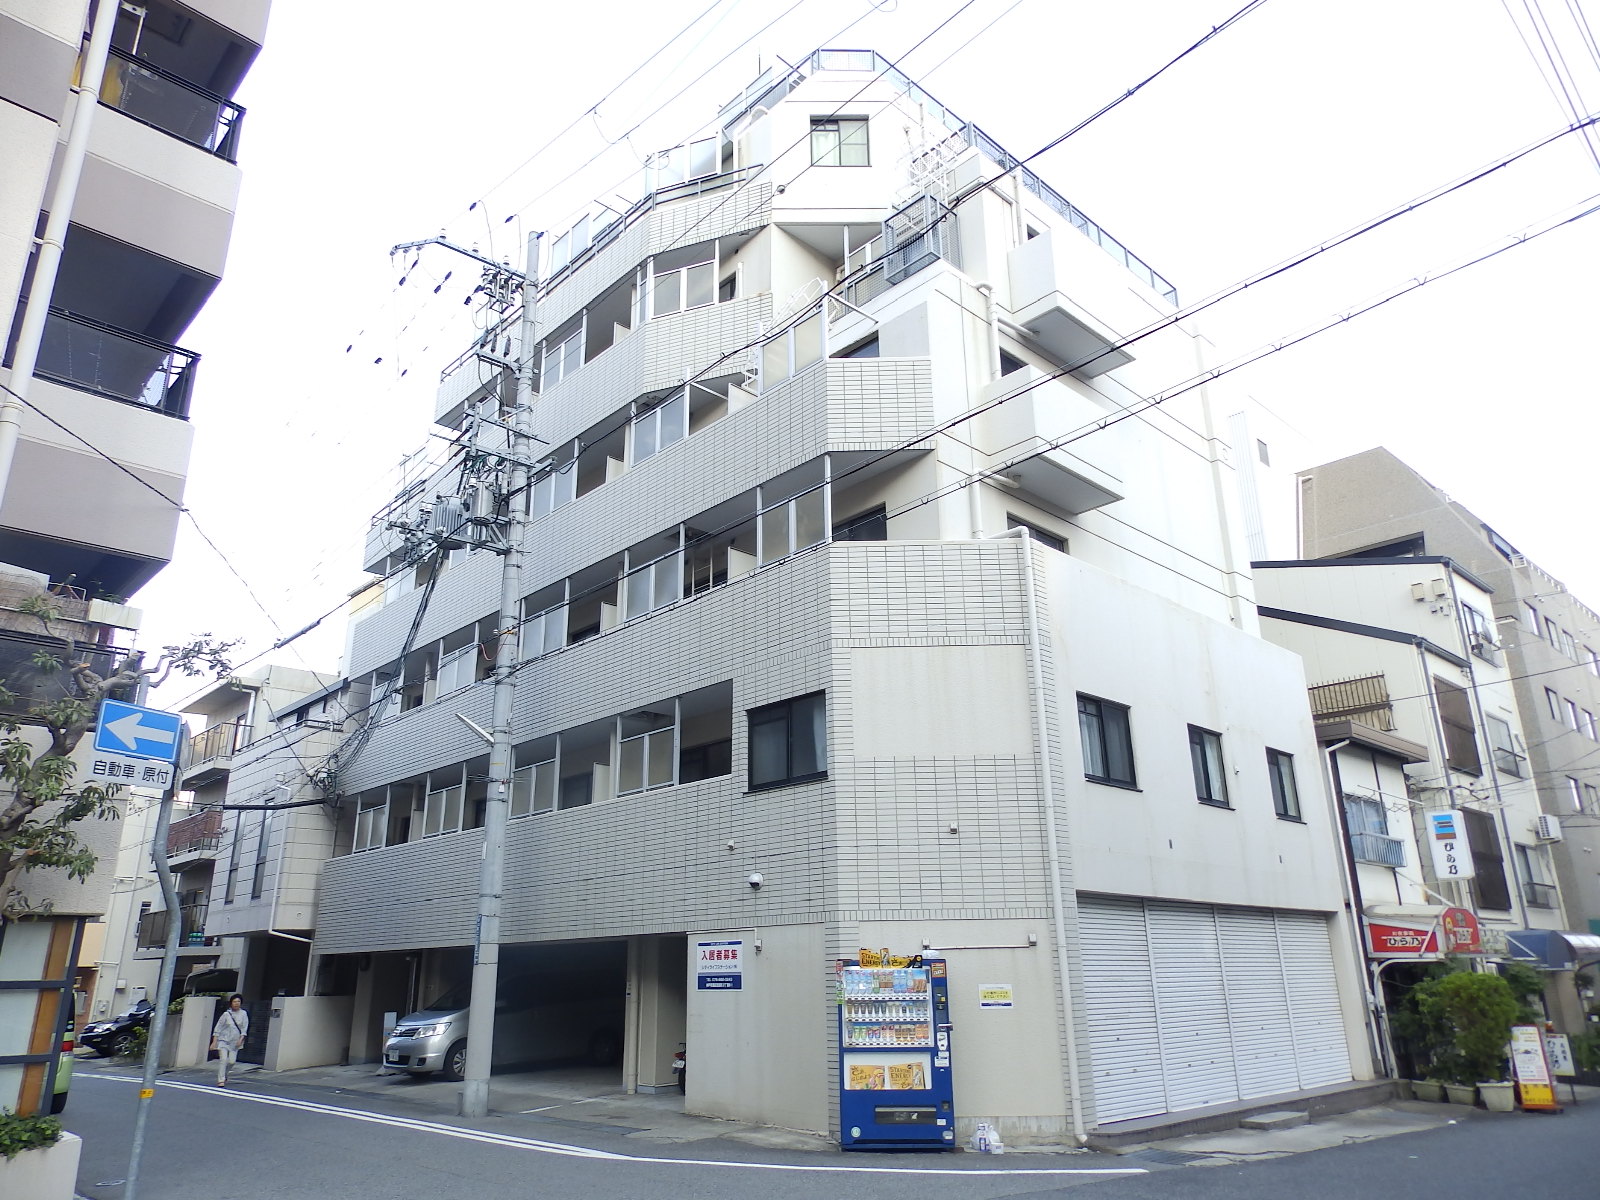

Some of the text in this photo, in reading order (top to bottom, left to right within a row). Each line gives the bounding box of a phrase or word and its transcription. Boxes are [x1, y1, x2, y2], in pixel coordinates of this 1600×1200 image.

[701, 949, 738, 961] 入居者募集
